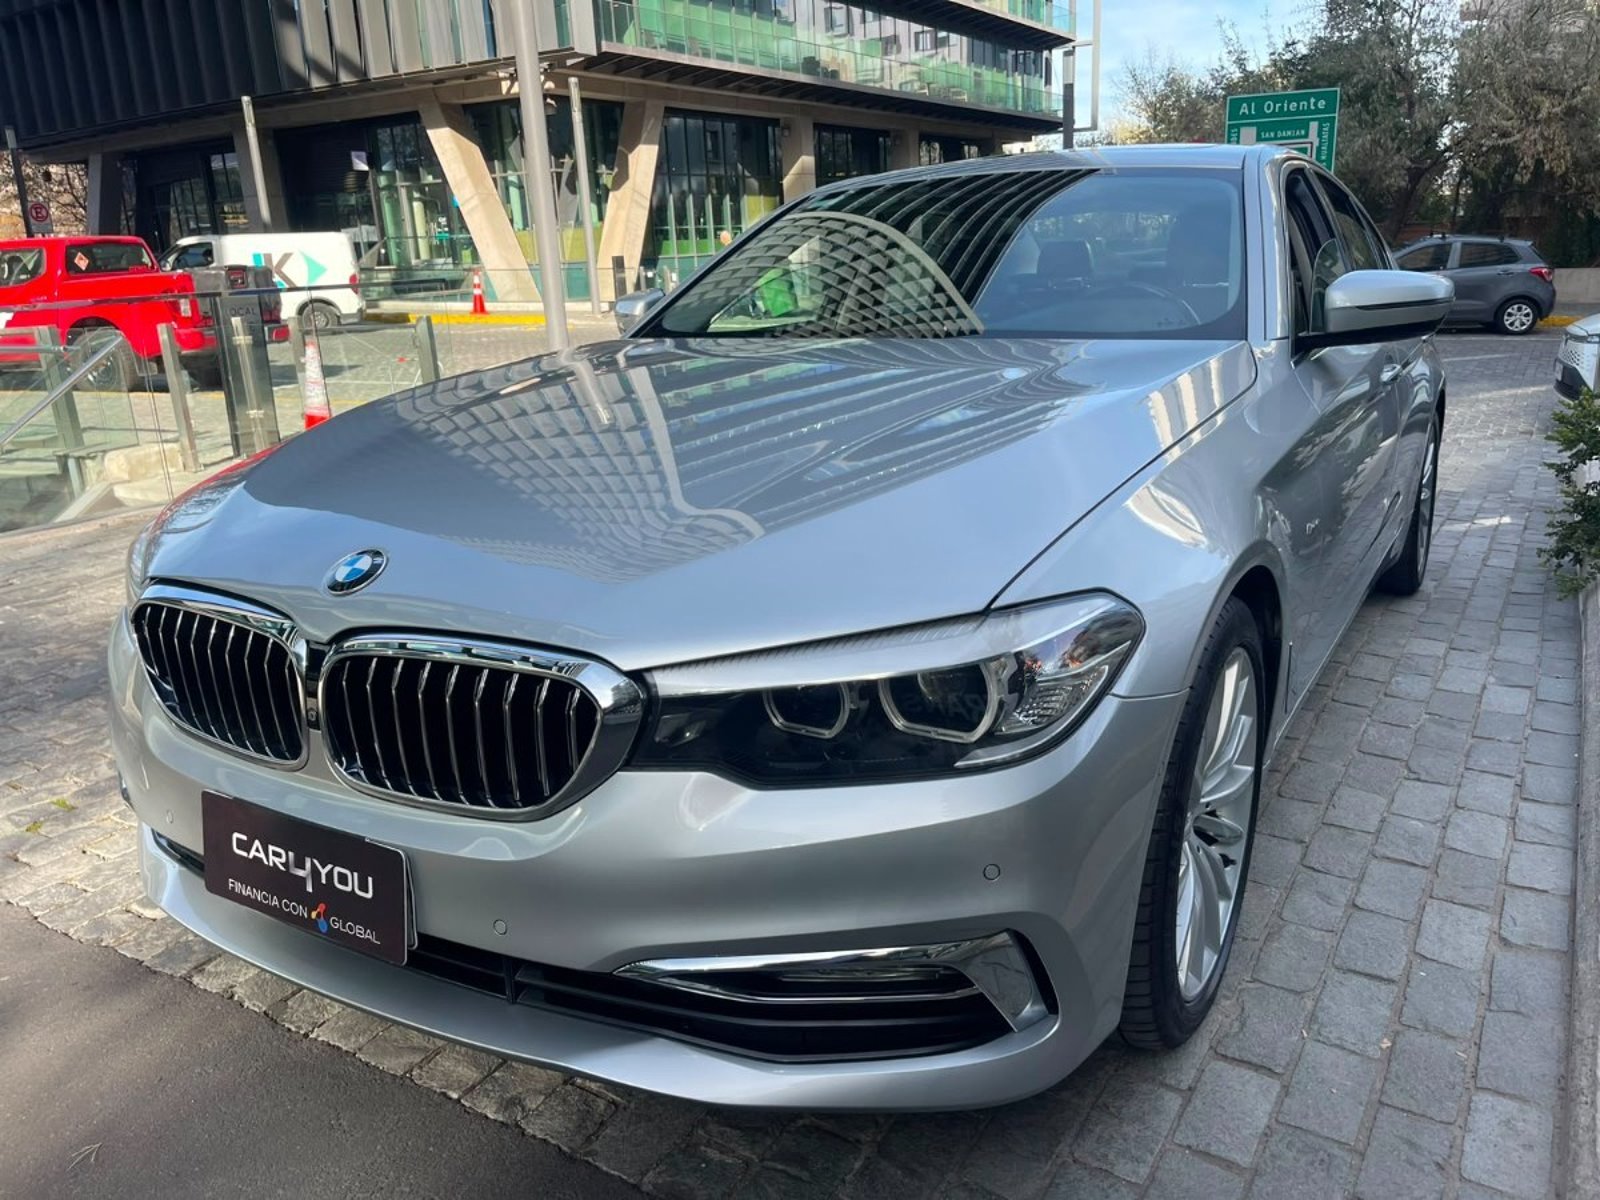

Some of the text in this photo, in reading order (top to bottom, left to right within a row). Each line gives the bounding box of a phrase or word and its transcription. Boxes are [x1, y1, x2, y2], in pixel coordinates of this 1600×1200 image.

[1239, 96, 1327, 116] Al Oriente
[1260, 129, 1306, 139] SAN DAMIAN
[231, 832, 374, 900] CAR4YOU
[228, 878, 381, 945] FINANCIA CON GLOBAL
